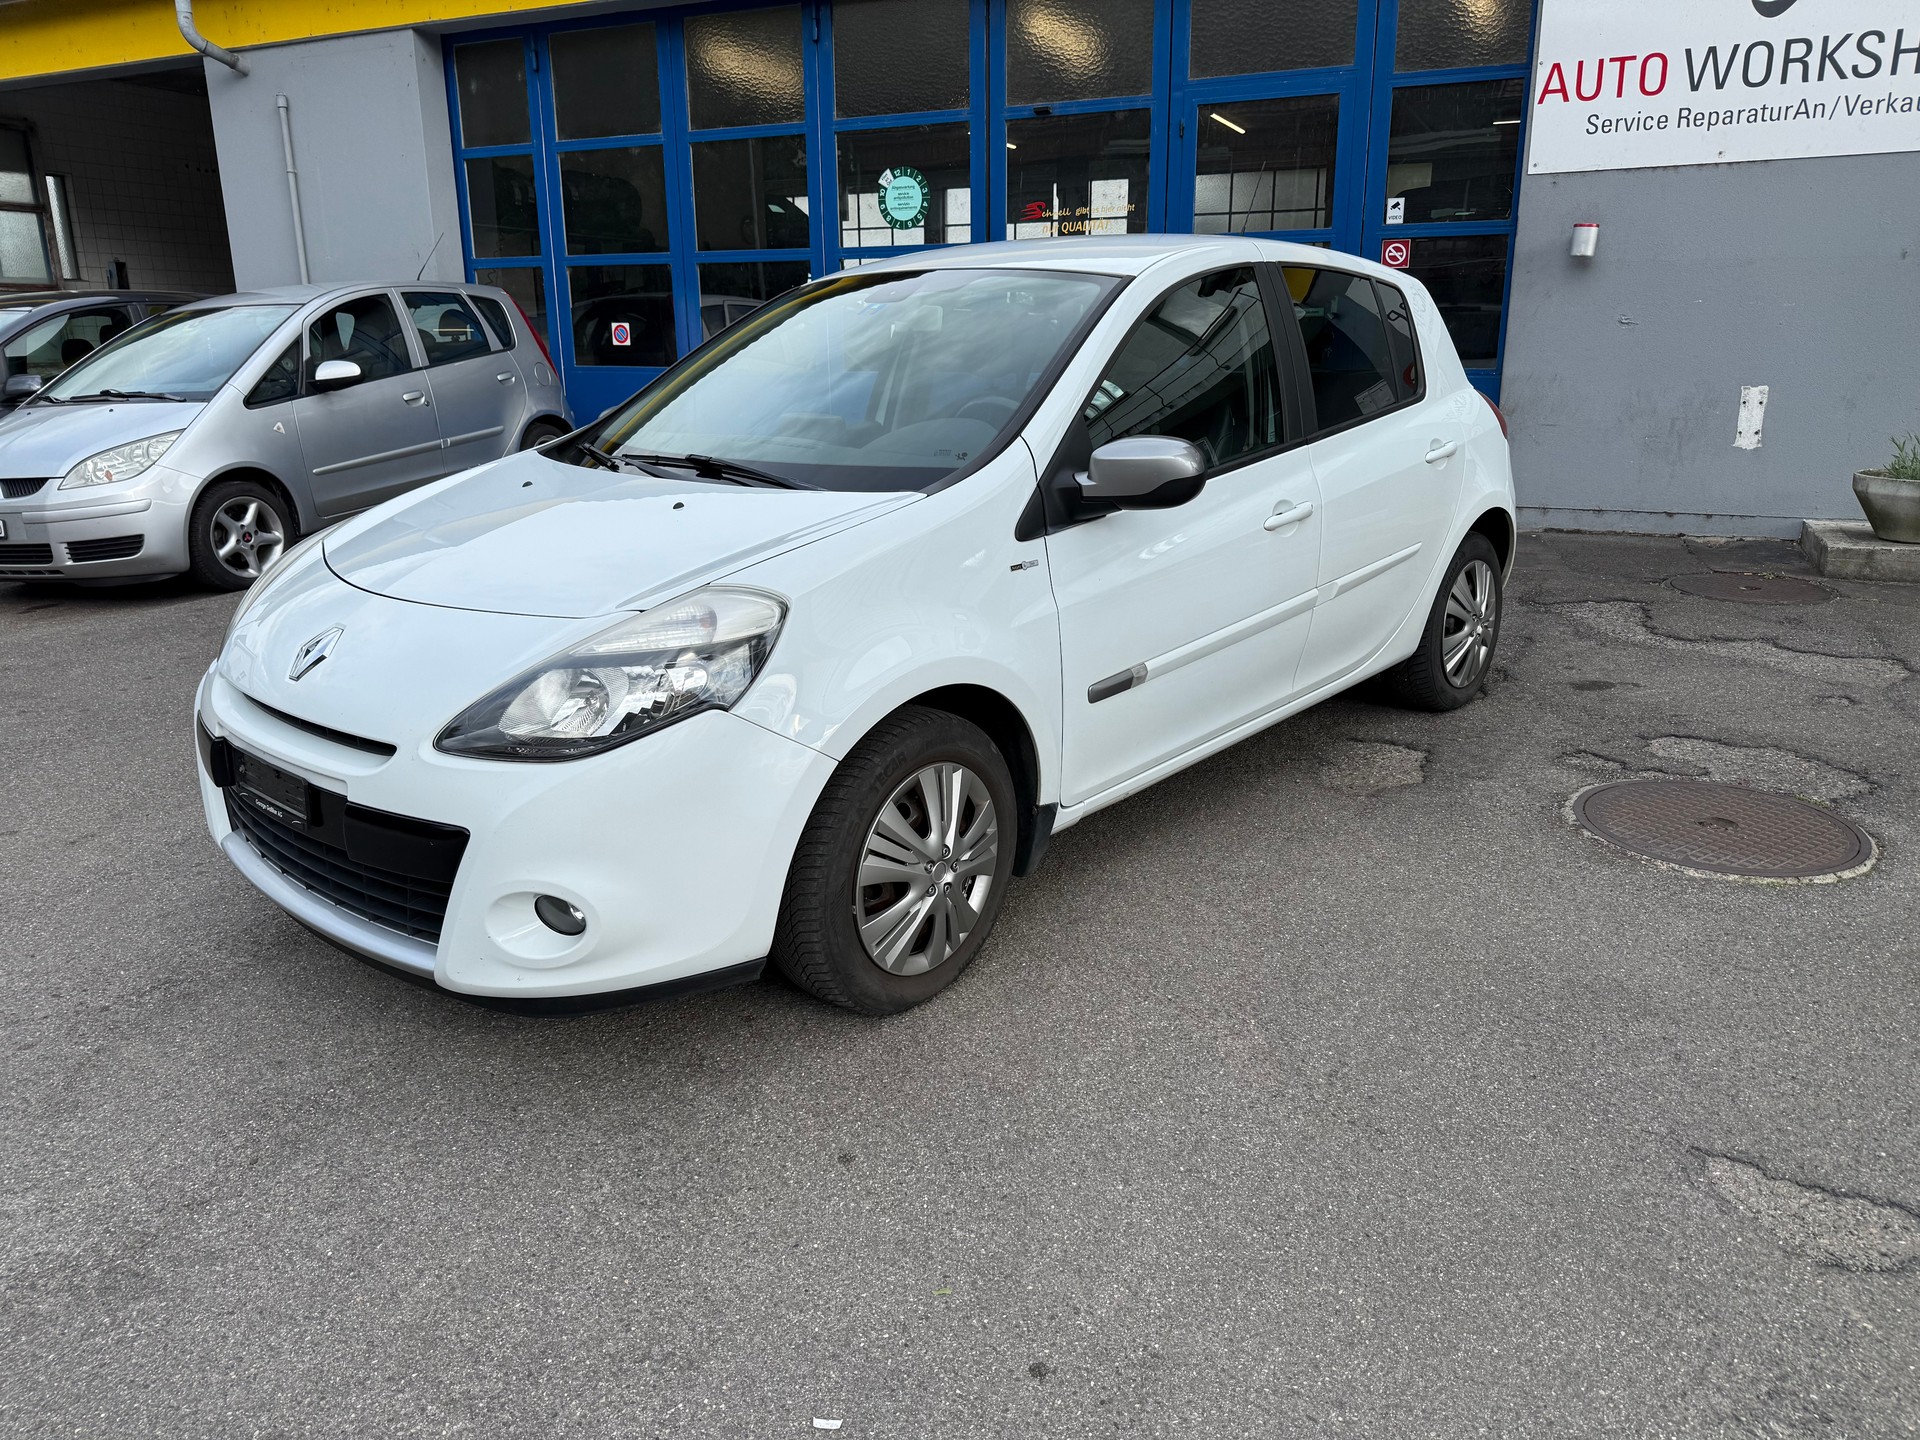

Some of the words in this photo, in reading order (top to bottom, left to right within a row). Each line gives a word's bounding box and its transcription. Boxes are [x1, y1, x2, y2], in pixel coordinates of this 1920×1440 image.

[1537, 52, 1668, 105] AUTO
[1685, 28, 1920, 92] WORKSH
[1586, 111, 1669, 135] Service
[894, 169, 901, 177] 12
[916, 175, 922, 183] 2
